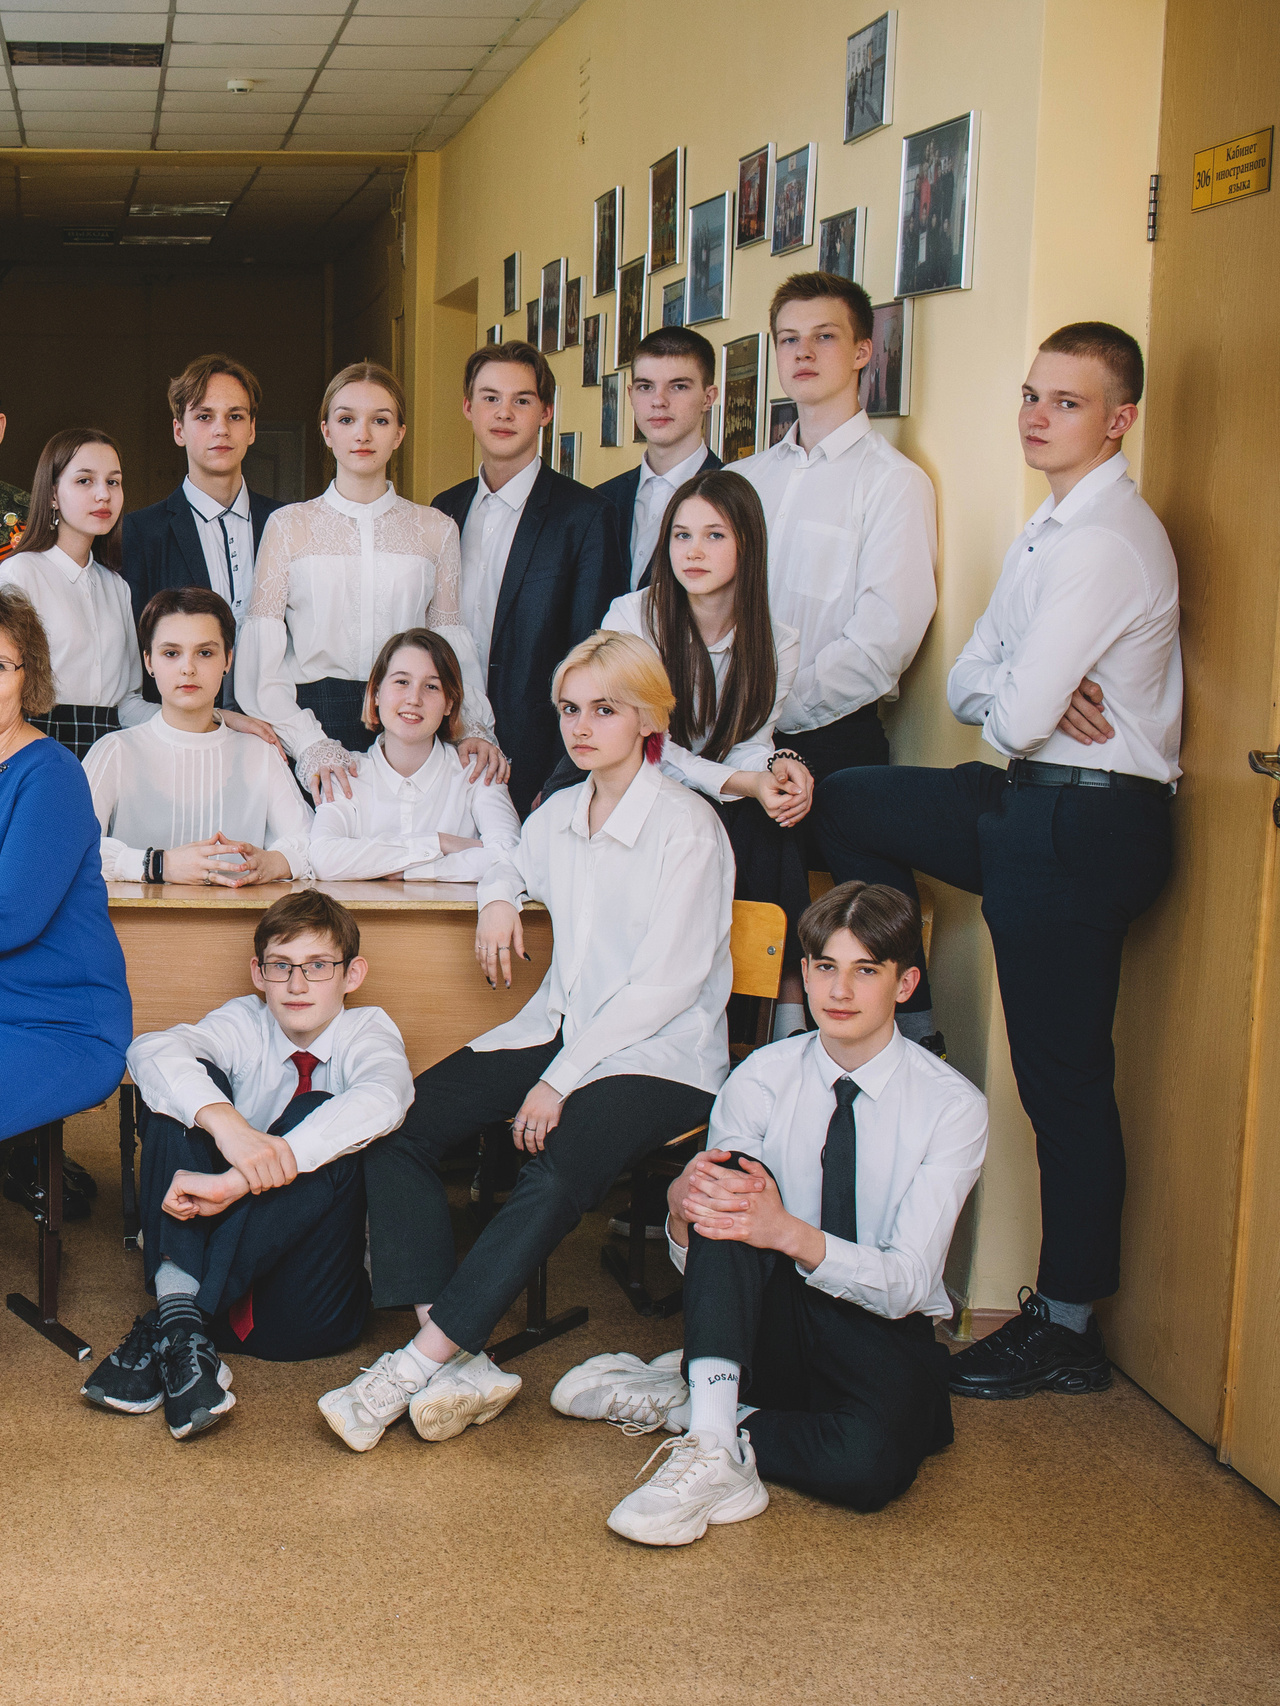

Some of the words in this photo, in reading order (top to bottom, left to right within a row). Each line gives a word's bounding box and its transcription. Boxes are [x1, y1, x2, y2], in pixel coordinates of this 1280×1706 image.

[1226, 143, 1257, 161] Кабинет
[1216, 158, 1266, 181] иностранного
[1195, 168, 1211, 190] 306
[1228, 180, 1251, 194] языка
[708, 1373, 726, 1385] LOS
